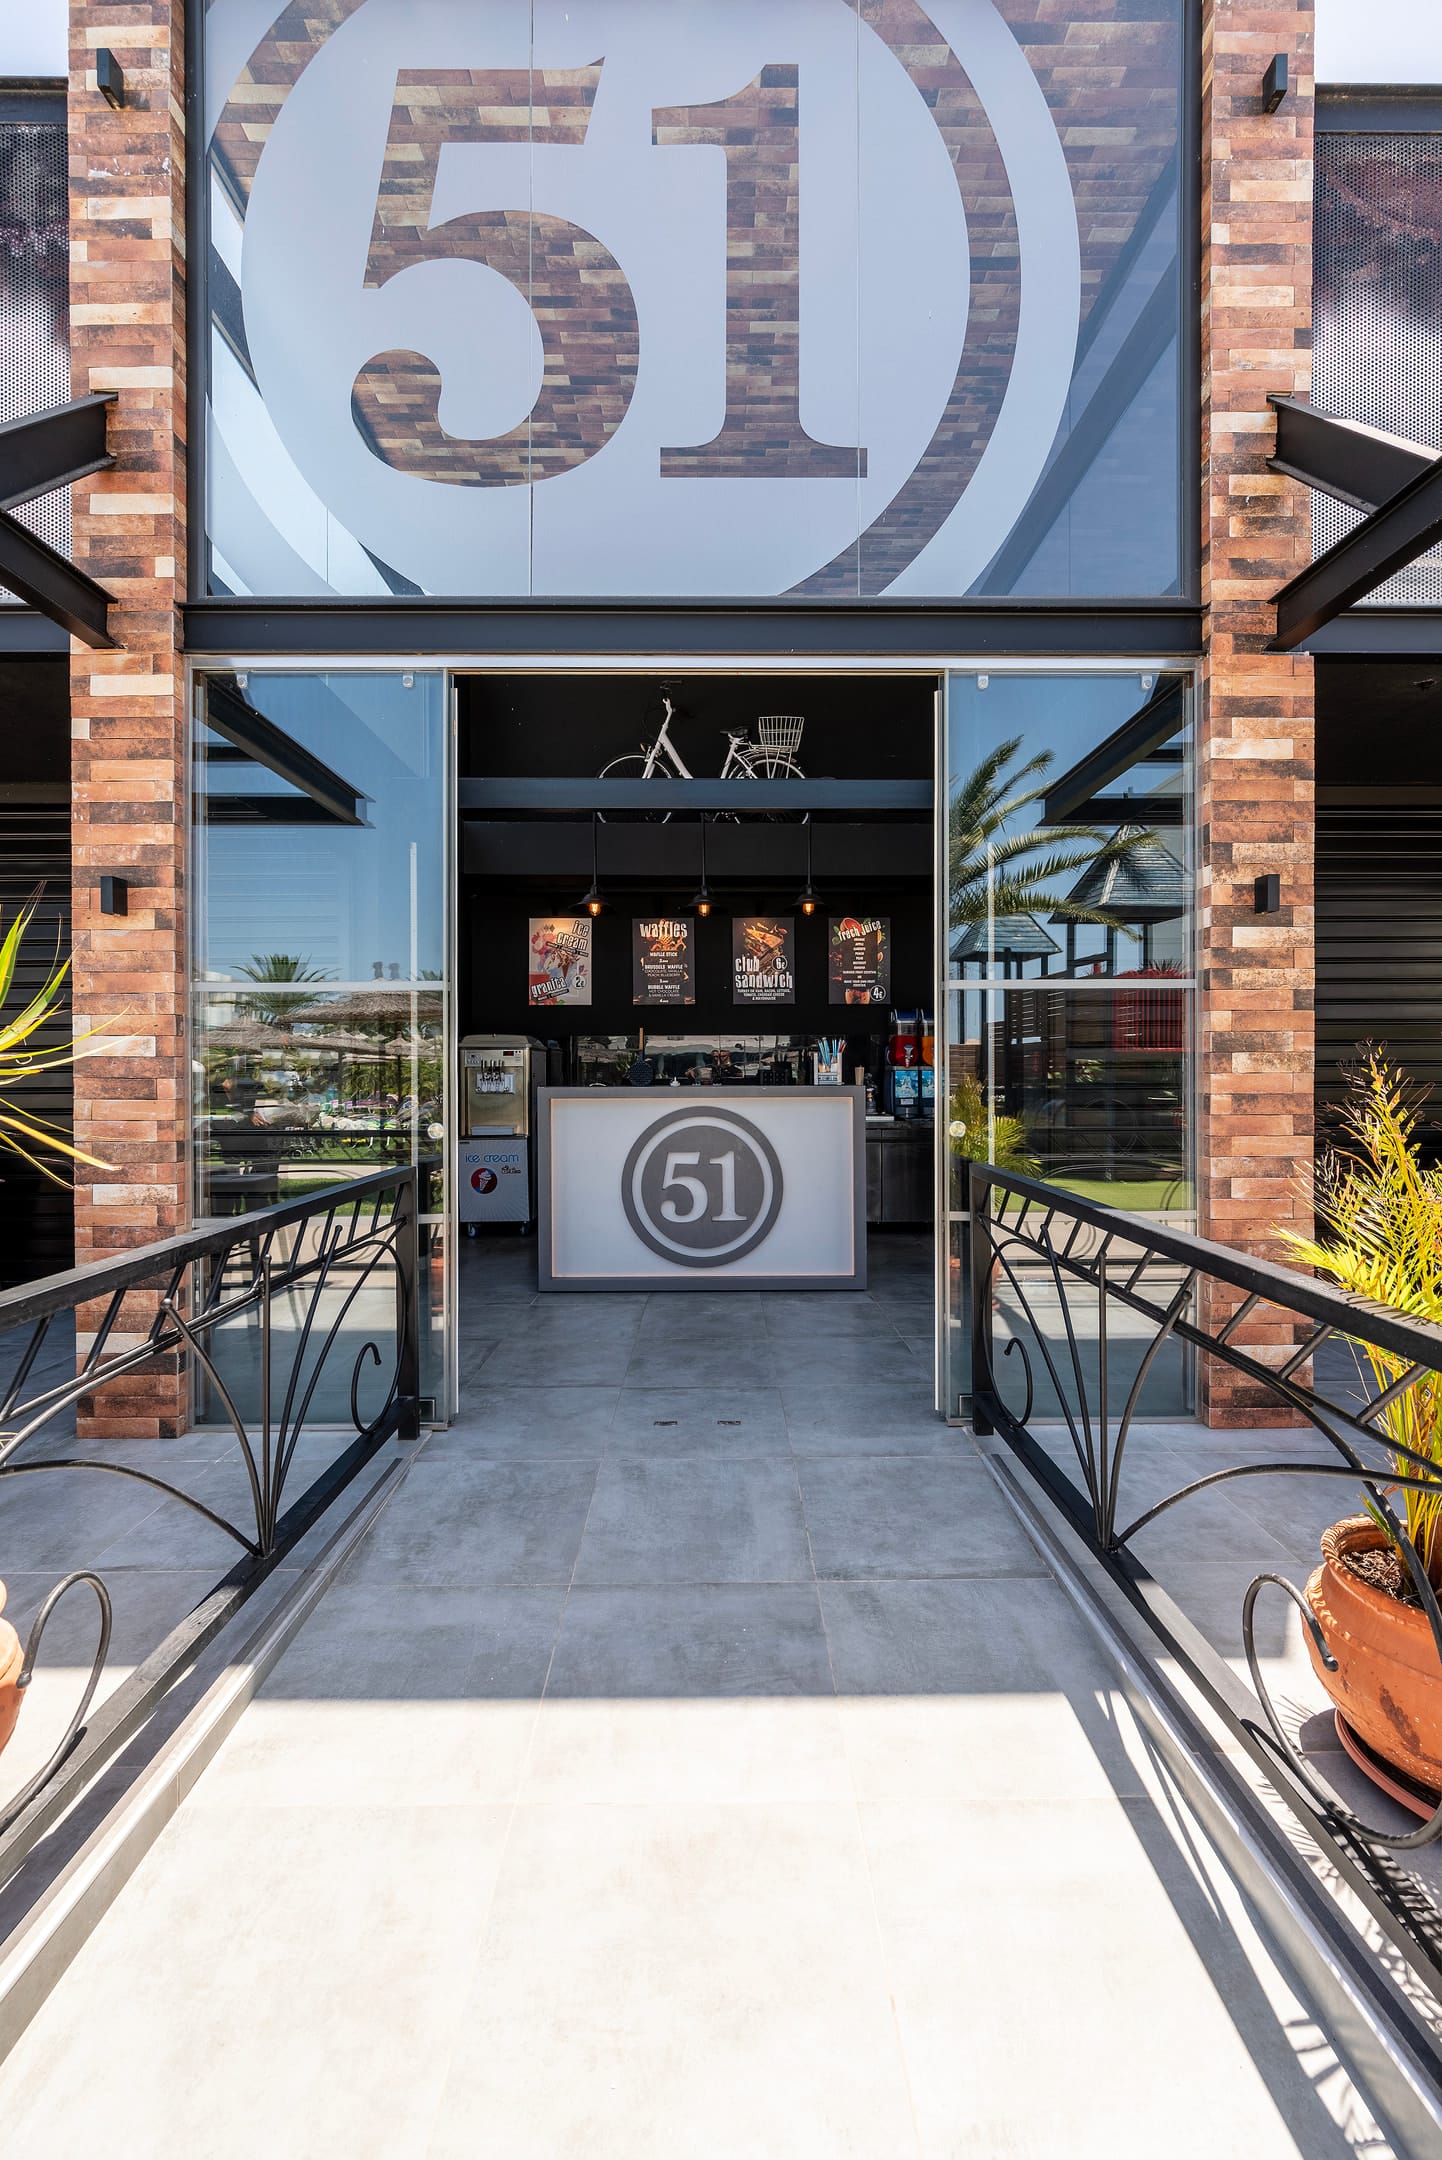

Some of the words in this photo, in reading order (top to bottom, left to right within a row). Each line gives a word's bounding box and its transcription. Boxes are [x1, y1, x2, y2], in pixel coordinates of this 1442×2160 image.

[351, 57, 867, 488] 51
[573, 920, 590, 937] ice
[639, 920, 688, 938] waffles
[861, 920, 882, 936] juice
[557, 932, 587, 950] cream
[735, 954, 760, 972] club
[531, 977, 567, 998] granita
[735, 971, 793, 988] sandwich
[465, 1152, 480, 1163] ice
[484, 1154, 519, 1163] cream
[660, 1151, 748, 1223] 51
